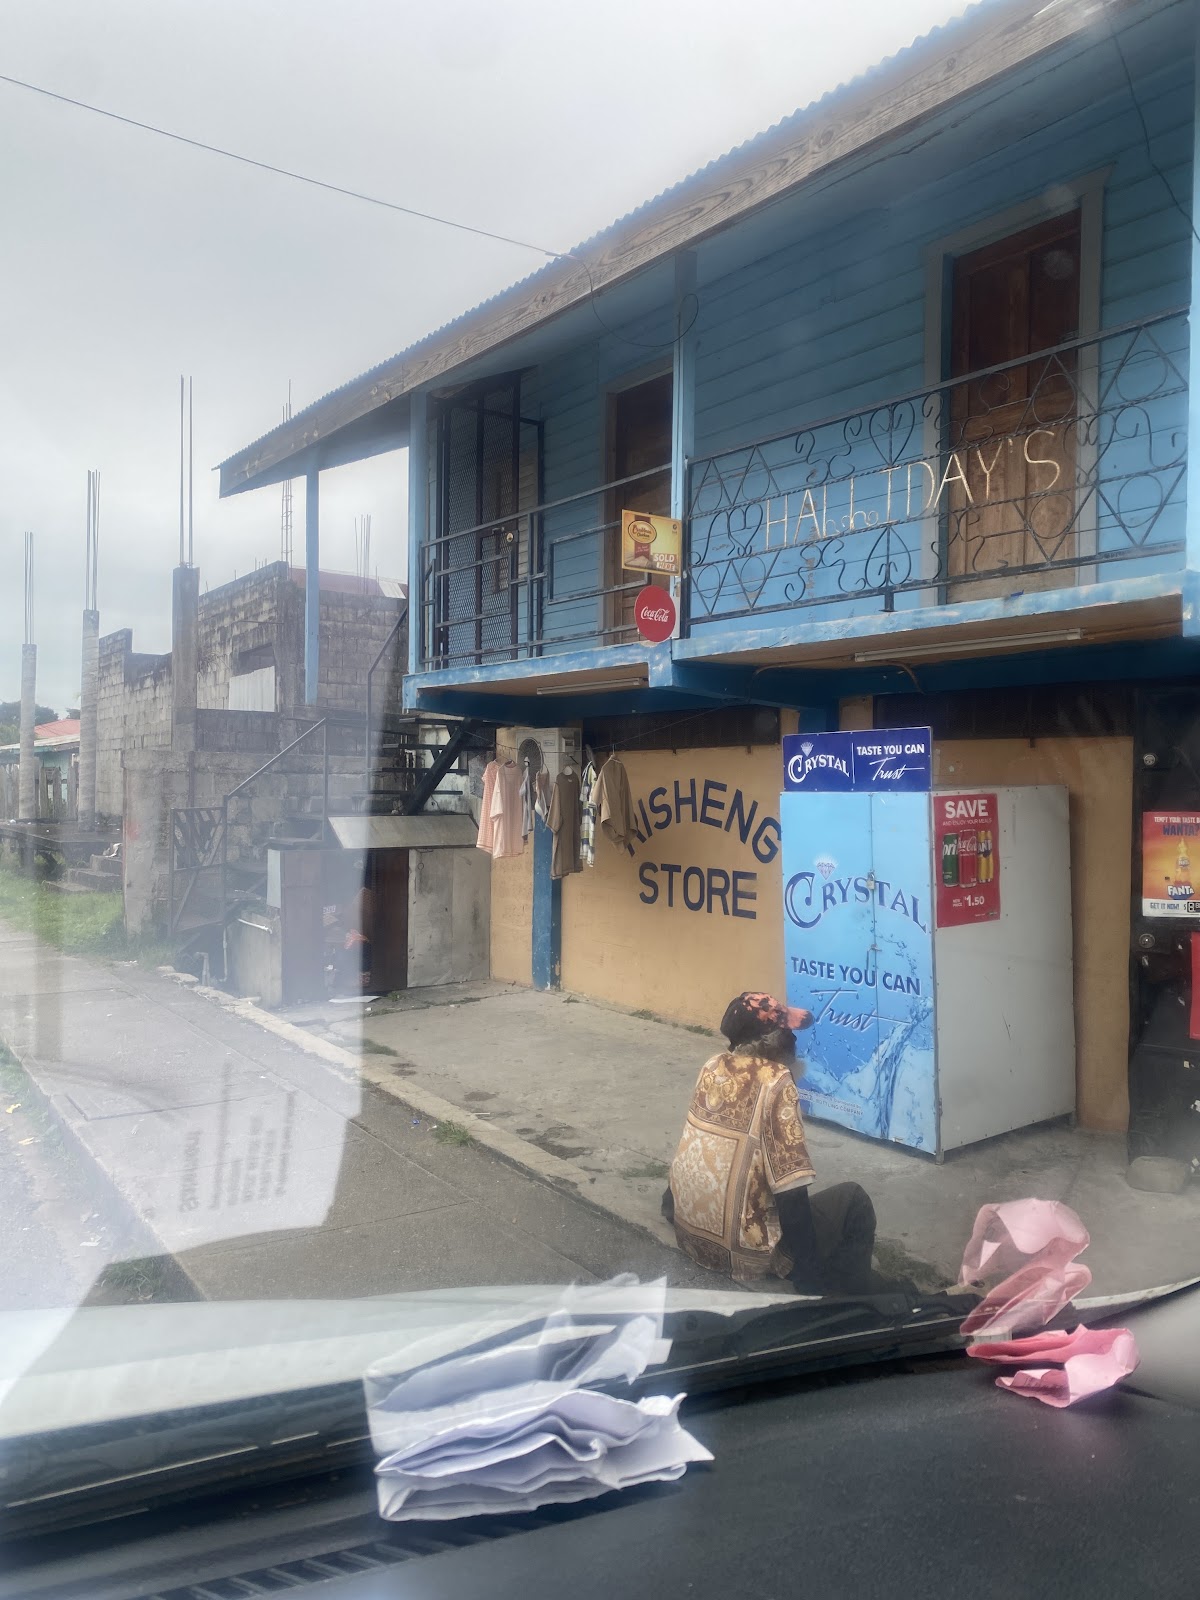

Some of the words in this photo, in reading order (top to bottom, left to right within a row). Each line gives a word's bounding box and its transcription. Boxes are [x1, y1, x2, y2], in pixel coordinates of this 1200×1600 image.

[652, 553, 675, 563] SOLD
[857, 746, 882, 756] TASTE
[884, 745, 902, 755] YOU
[904, 743, 925, 754] CAN
[788, 754, 850, 783] CRYSTAL
[869, 756, 925, 781] Trust
[944, 799, 989, 819] SAVE
[639, 861, 758, 920] STORE
[785, 871, 927, 935] CRYSTAL
[1167, 885, 1195, 896] FANTA
[791, 956, 835, 980] TASTE
[839, 964, 877, 987] YOU
[882, 972, 921, 996] CAN
[810, 987, 912, 1032] Trust
